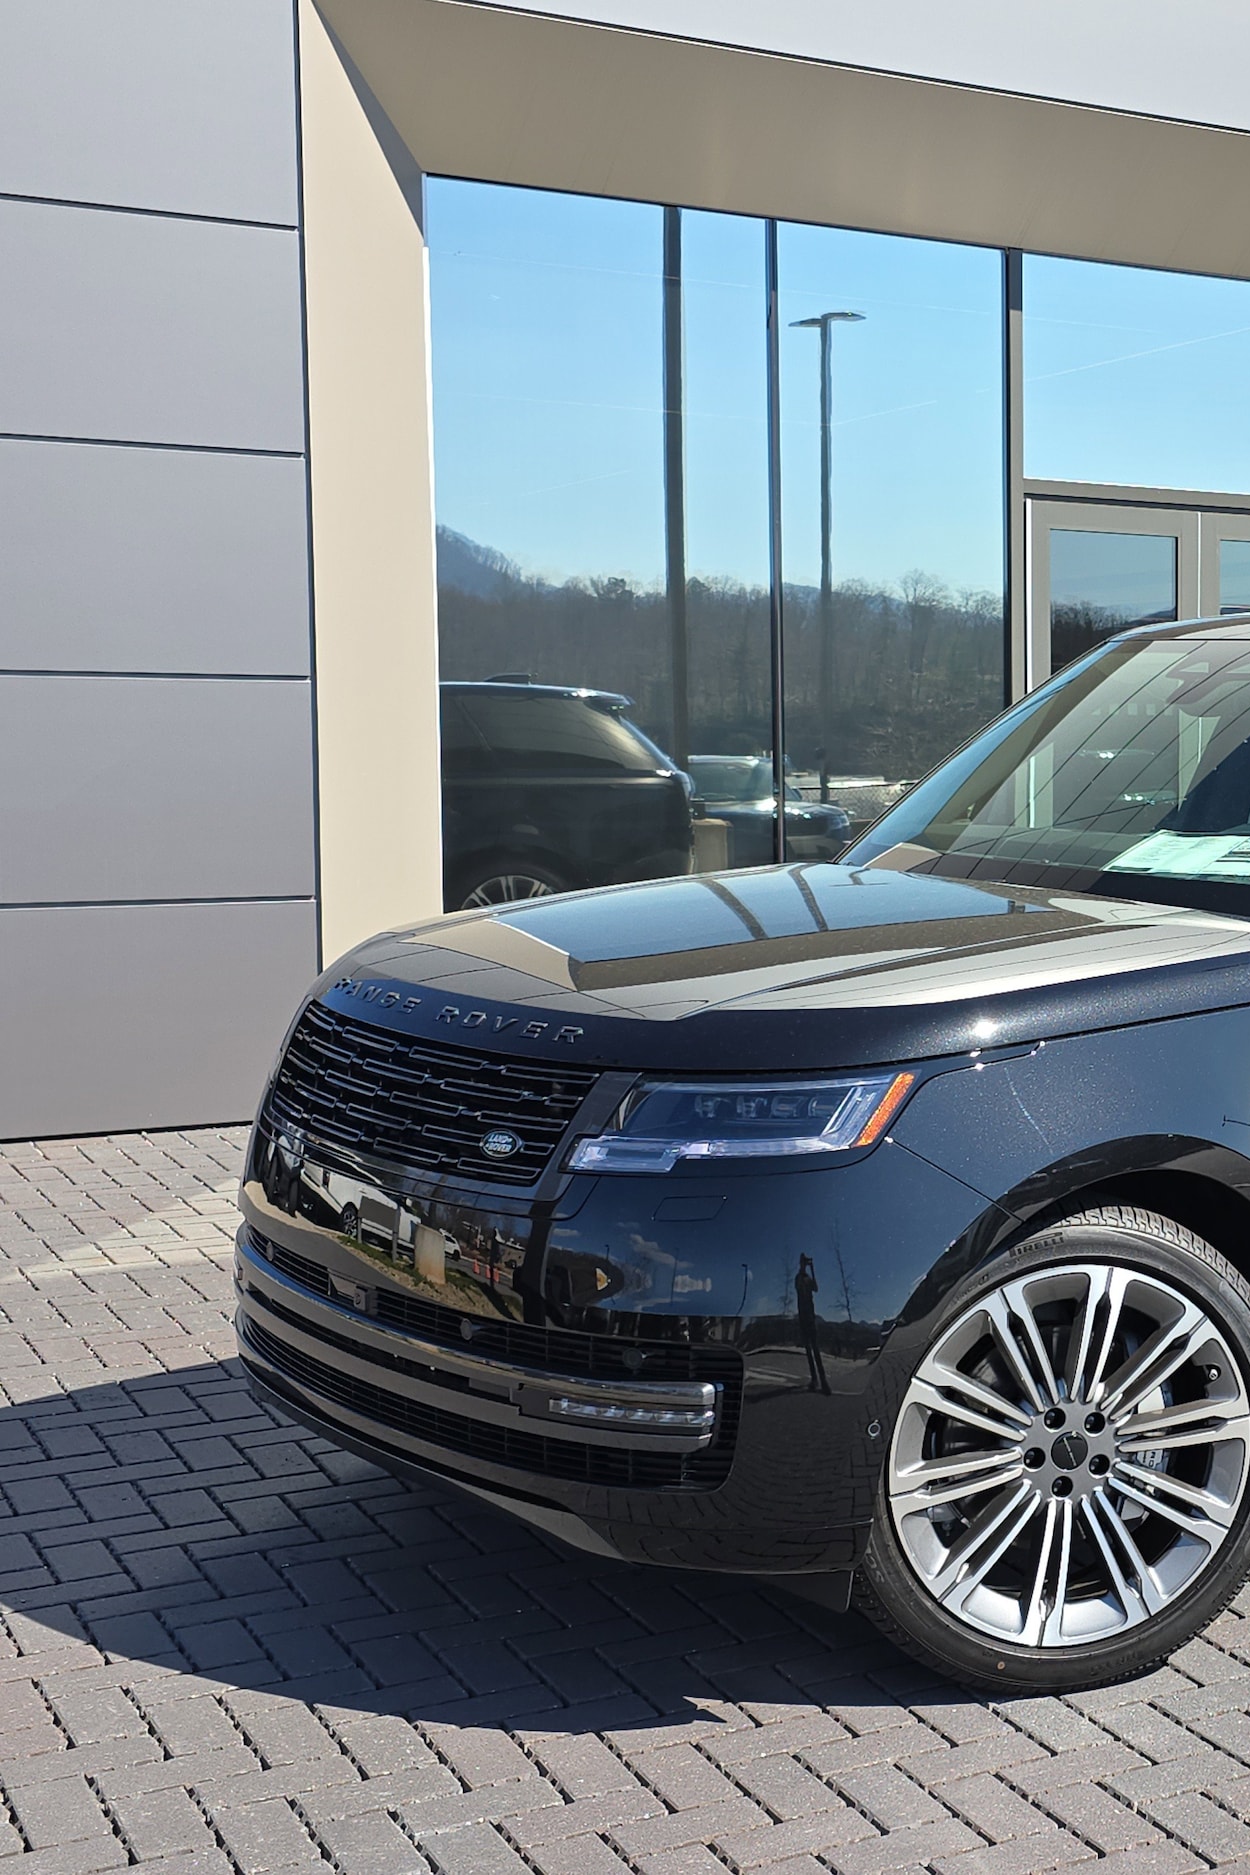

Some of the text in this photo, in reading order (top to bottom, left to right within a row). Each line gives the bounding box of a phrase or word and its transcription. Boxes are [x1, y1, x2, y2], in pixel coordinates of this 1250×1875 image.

[333, 977, 584, 1044] RANGE ROVER
[487, 1142, 513, 1153] ROVER
[488, 1132, 513, 1144] LAND
[1009, 1231, 1065, 1258] PIRELLI
